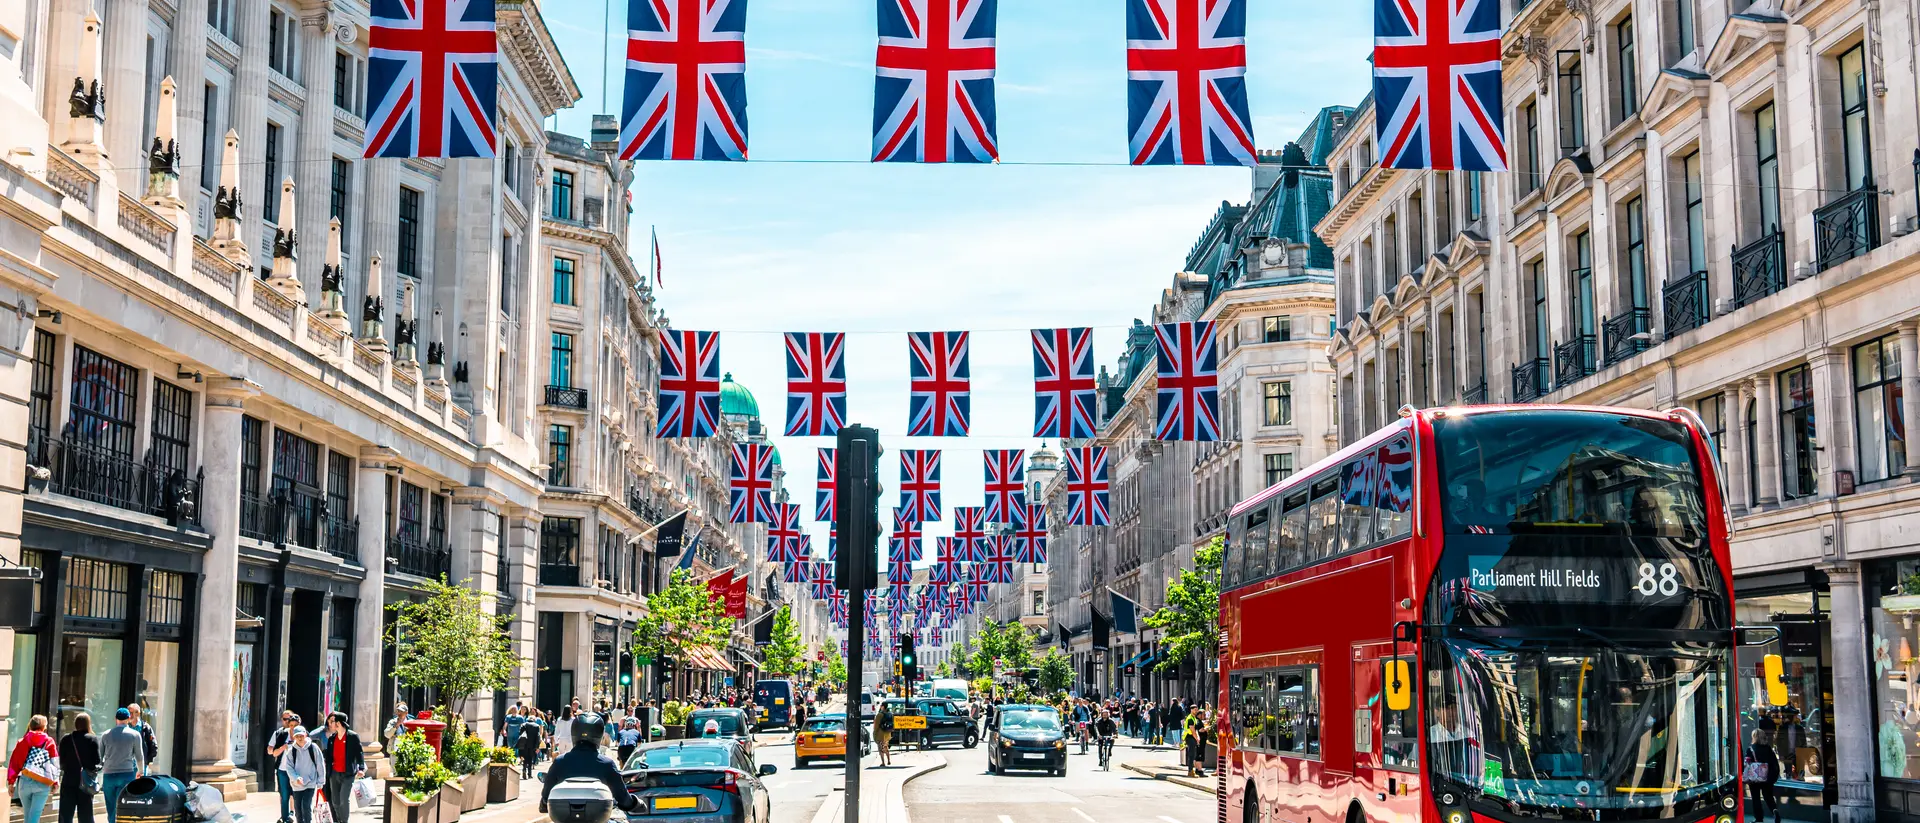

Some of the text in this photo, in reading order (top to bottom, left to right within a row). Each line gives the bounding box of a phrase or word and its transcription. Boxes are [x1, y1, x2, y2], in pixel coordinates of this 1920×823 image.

[1472, 568, 1600, 588] Parliament Hill Fields
[1638, 562, 1679, 596] 88
